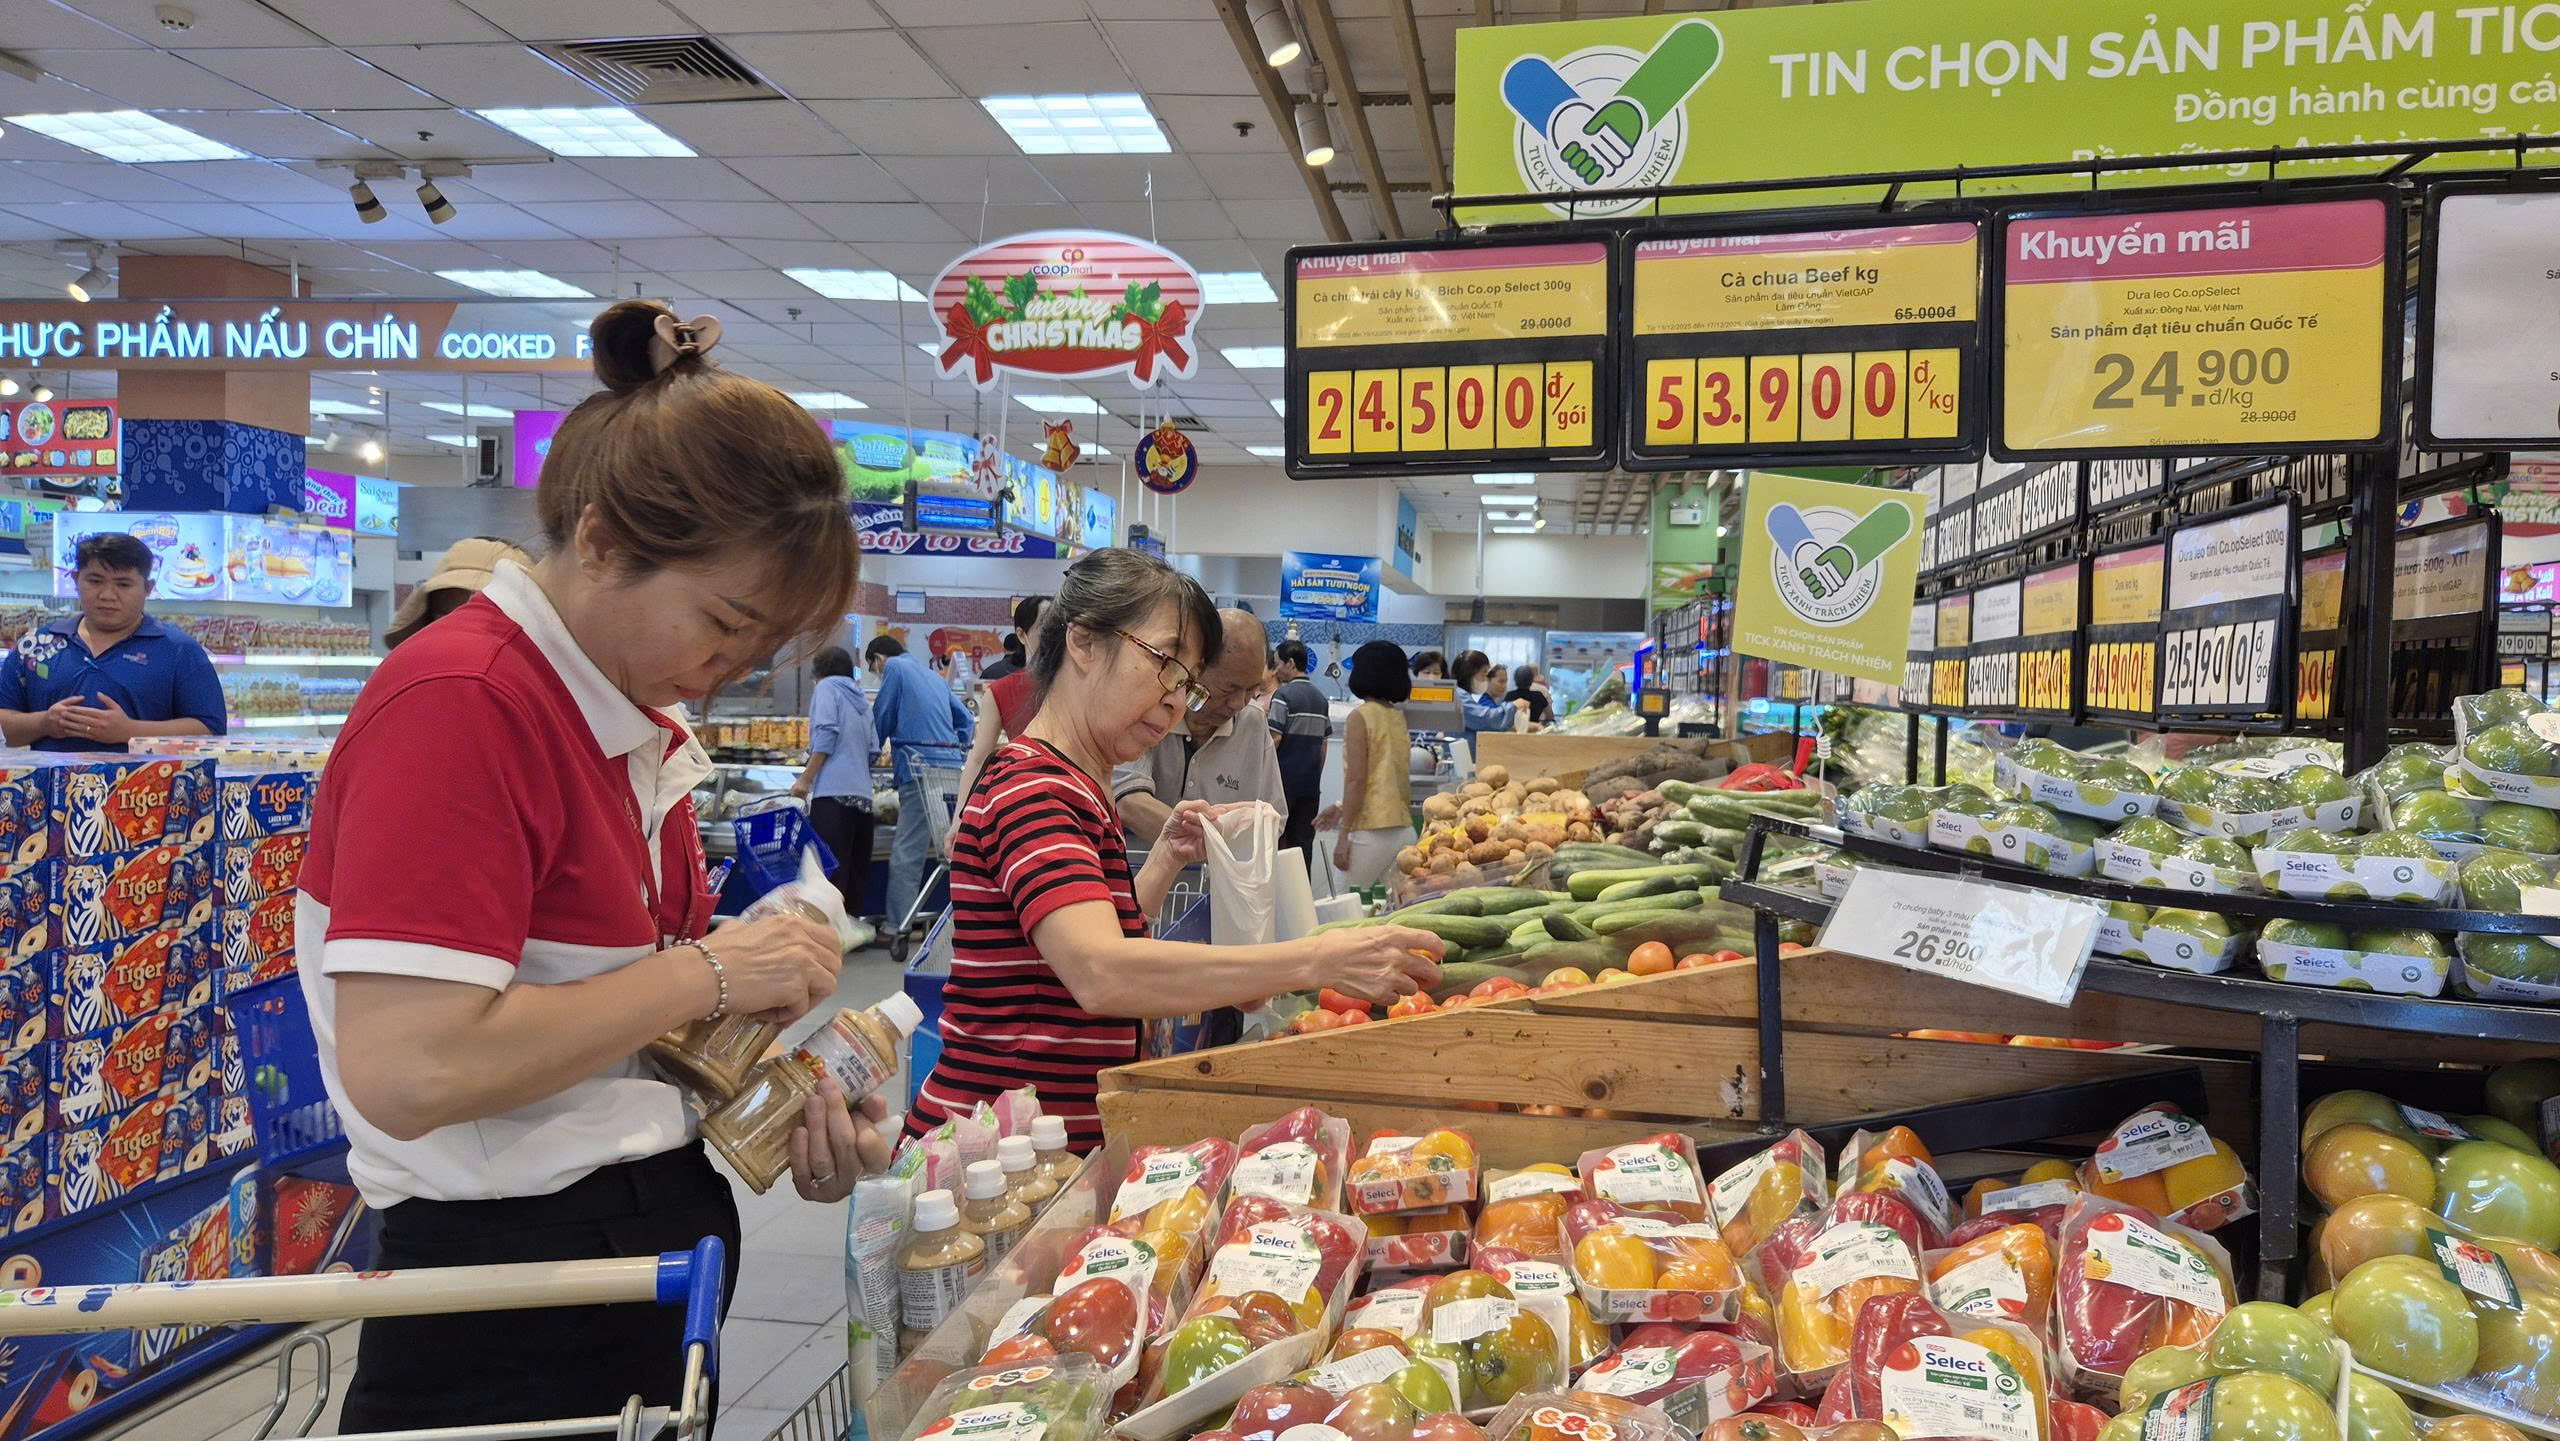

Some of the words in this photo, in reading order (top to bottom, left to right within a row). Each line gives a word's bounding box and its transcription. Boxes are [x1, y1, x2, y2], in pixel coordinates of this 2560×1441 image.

[1769, 49, 1867, 98] TIN
[1885, 35, 2068, 97] CHỌN
[2087, 13, 2220, 78] SẢN
[2242, 0, 2435, 69] PHẨM
[2175, 88, 2276, 126] Đồng
[2288, 82, 2385, 116] hành
[2397, 79, 2498, 114] cùng
[1529, 145, 1550, 180] TICK
[1639, 138, 1673, 187] NHIỆM
[2020, 221, 2166, 264] Khuyến
[2178, 219, 2250, 253] mãi
[1752, 270, 1798, 287] chua
[1806, 266, 1849, 284] Beef
[1856, 265, 1878, 284] kg
[1467, 284, 1501, 297] Co.op
[1505, 281, 1540, 292] Select
[1544, 280, 1572, 292] 300g
[1835, 287, 1874, 299] VietGAP
[2127, 289, 2151, 300] Dưa
[2153, 288, 2170, 299] leo
[2172, 287, 2241, 299] Co.opSelect
[1025, 297, 1113, 325] merry
[1895, 306, 1956, 320] 65.000đ
[2223, 302, 2243, 311] Nam
[97, 306, 210, 359] PHẨM
[226, 307, 308, 359] NẤU
[325, 313, 418, 360] CHÍN
[442, 333, 556, 360] COOKED
[987, 319, 1143, 350] CHRISTMAS
[2050, 323, 2081, 340] Sản
[2085, 321, 2128, 341] phẩm
[2132, 321, 2158, 338] đạt
[2162, 320, 2191, 335] tiêu
[2195, 316, 2245, 333] chuẩn
[2250, 315, 2293, 331] Quốc
[2297, 313, 2319, 329] Tế
[1656, 362, 1896, 430] 53.900
[1914, 360, 1954, 414] đ/kg
[2209, 387, 2254, 408] đ/kg
[1316, 376, 1535, 440] 24.500
[1547, 372, 1586, 430] đ/gói
[2240, 410, 2296, 424] 28.900đ
[859, 527, 920, 555] ady
[925, 528, 962, 552] to
[968, 529, 1026, 553] eat
[2265, 528, 2284, 546] 300g
[1780, 565, 1791, 588] TICK
[1788, 589, 1812, 612] XANH
[1815, 604, 1848, 617] TRÁCH
[1772, 635, 1805, 654] XANH
[1808, 641, 1849, 663] TRÁCH
[1851, 650, 1892, 672] NHIỆM
[2168, 634, 2248, 690] 25.900
[2041, 783, 2074, 798] Select
[2489, 779, 2531, 794] Select
[117, 788, 168, 817] Tiger
[257, 783, 304, 813] Tiger
[1936, 819, 1962, 833] Select
[2272, 814, 2298, 829] Select
[262, 848, 300, 871] Tiger
[2111, 851, 2142, 867] Select
[2286, 860, 2327, 873] Select
[116, 876, 167, 906] Tiger
[1928, 906, 1946, 917] baby
[1946, 910, 1953, 918] 3
[2100, 926, 2121, 939] lect
[2294, 955, 2335, 969] Select
[115, 963, 165, 991] Tiger
[2497, 984, 2540, 997] Select
[114, 1043, 163, 1074] Tiger
[2121, 1119, 2165, 1140] Select
[112, 1129, 161, 1161] Tiger
[1618, 1153, 1658, 1167] Select
[1366, 1188, 1396, 1200] Select
[1254, 1234, 1297, 1250] Select
[1368, 1246, 1386, 1257] lect
[1514, 1270, 1559, 1281] Select
[1611, 1298, 1648, 1310] Select
[1925, 1352, 1986, 1373] Select
[960, 1411, 1014, 1426] Select
